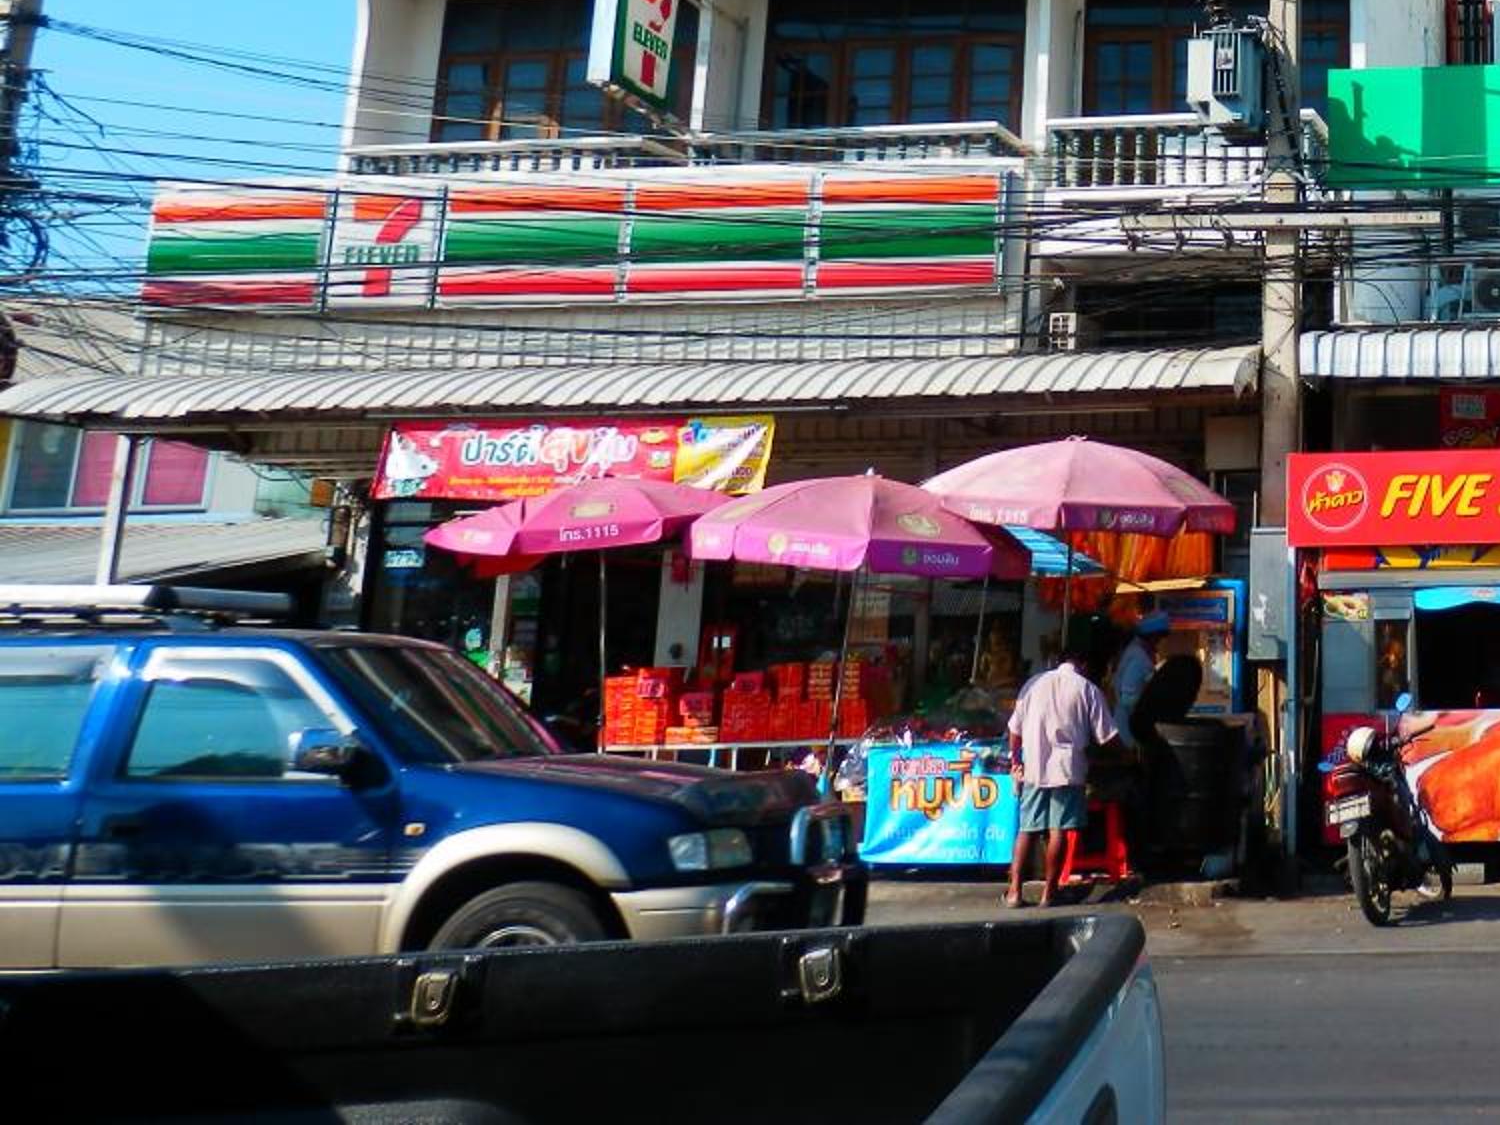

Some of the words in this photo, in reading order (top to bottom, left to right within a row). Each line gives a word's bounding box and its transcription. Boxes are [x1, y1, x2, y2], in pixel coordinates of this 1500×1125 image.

[352, 196, 423, 297] 7
[1307, 489, 1364, 516] ห้าดาว
[1380, 474, 1493, 518] FIVE
